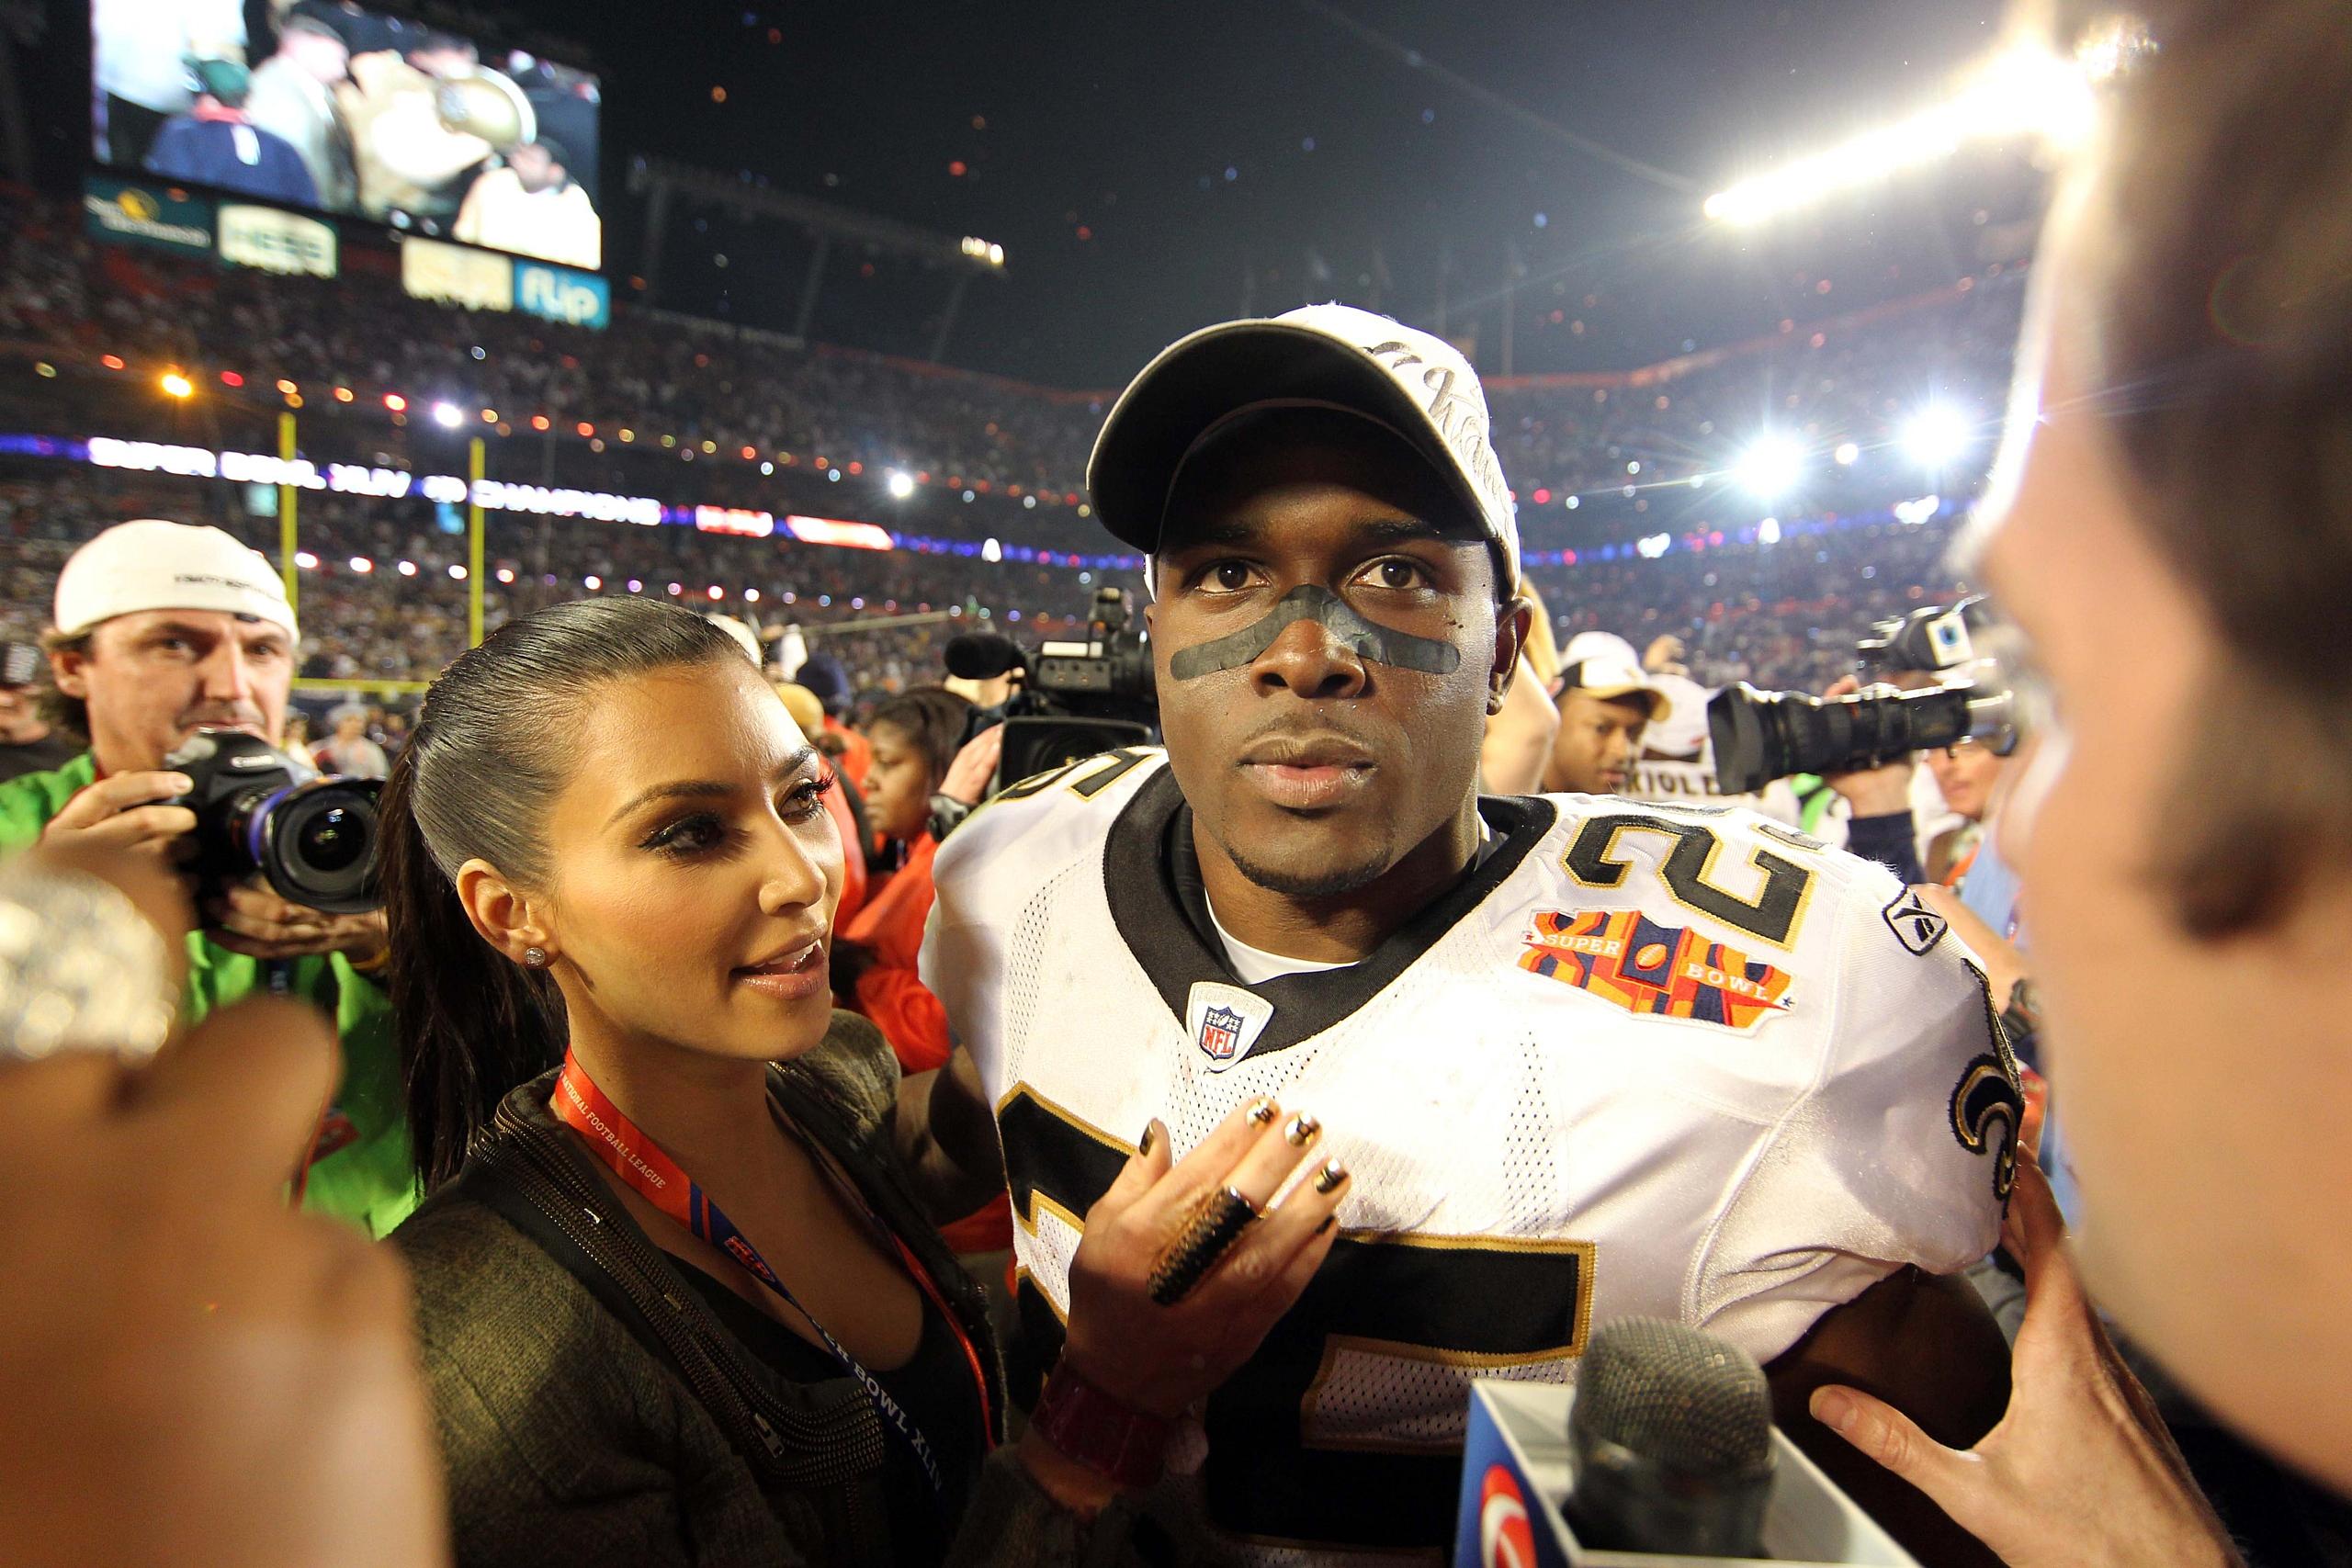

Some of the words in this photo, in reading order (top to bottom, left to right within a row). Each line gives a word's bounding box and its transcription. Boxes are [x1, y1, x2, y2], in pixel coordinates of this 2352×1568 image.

[523, 265, 600, 326] flip
[1543, 933, 1622, 956] SUPER
[1686, 963, 1770, 1001] BOWL
[1204, 1025, 1233, 1055] NFL
[562, 1073, 589, 1115] NATIONAL
[586, 1111, 629, 1157] FOOTBALL
[628, 1154, 667, 1190] LEAGUE
[854, 1360, 909, 1434] BOWL
